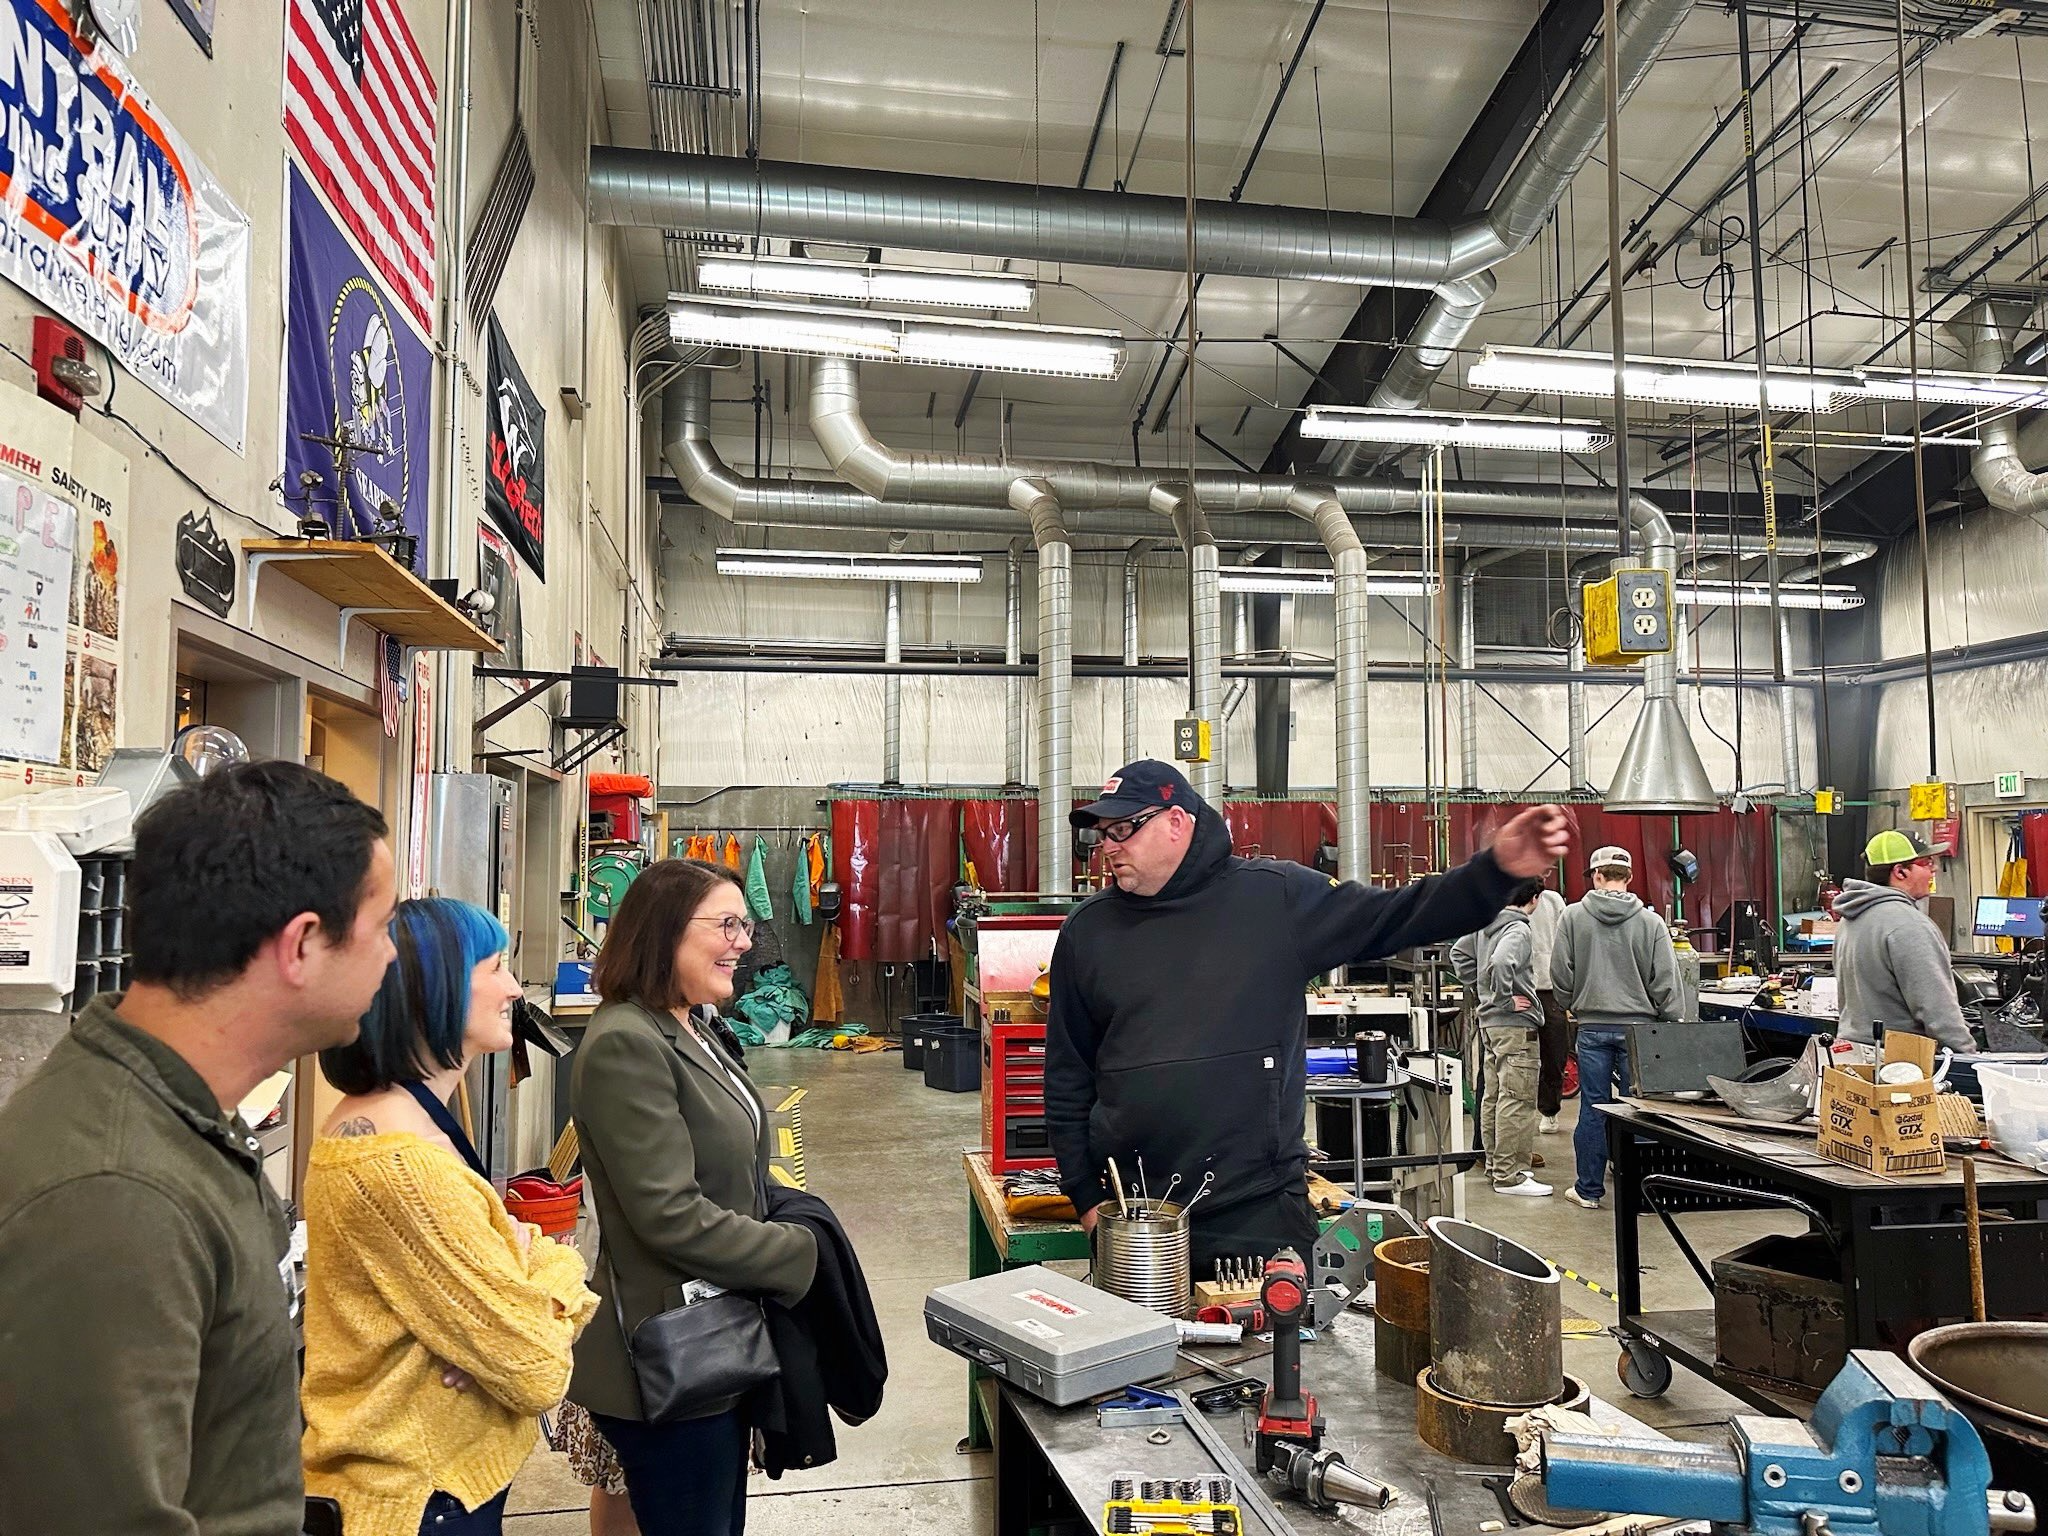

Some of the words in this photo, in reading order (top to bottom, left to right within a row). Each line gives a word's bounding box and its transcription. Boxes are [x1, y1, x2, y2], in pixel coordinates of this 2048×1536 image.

[0, 443, 42, 476] MITH
[90, 492, 112, 518] TIPS
[84, 632, 91, 649] 3
[25, 767, 33, 785] 5
[1999, 775, 2017, 793] EXIT
[1830, 1113, 1853, 1131] GTX
[1898, 1123, 1923, 1135] GTX
